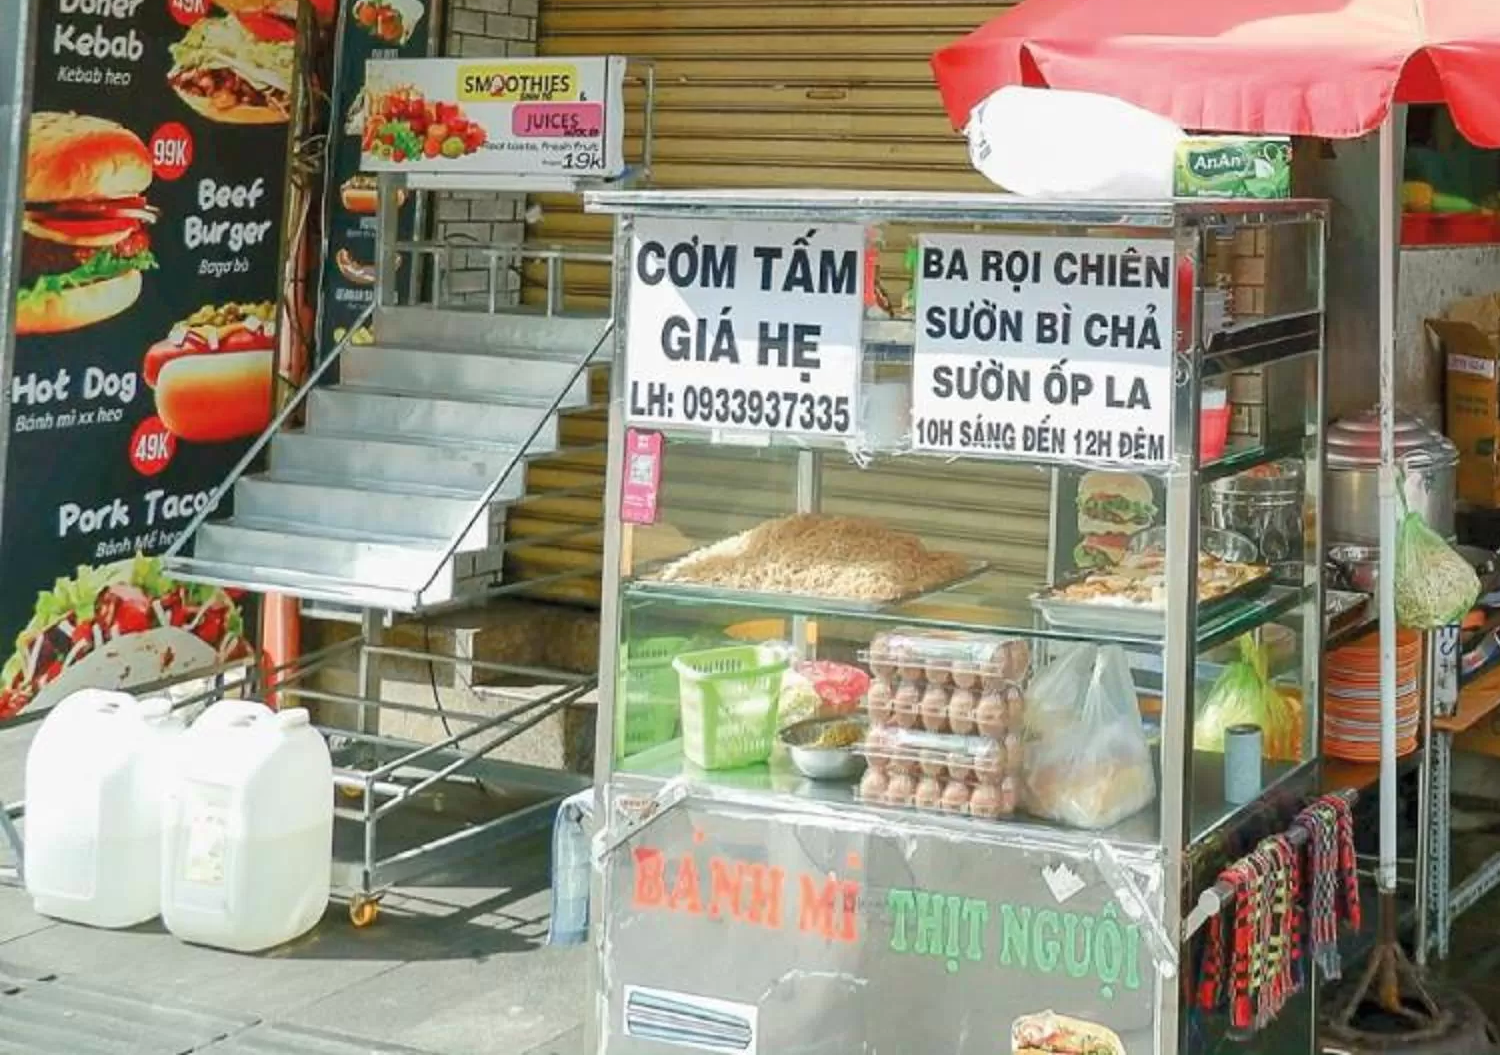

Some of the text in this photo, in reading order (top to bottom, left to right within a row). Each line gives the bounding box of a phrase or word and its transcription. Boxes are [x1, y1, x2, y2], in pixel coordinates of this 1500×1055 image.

[53, 24, 144, 61] Kebab
[57, 66, 131, 85] Kebab heo
[525, 113, 580, 132] JUICES
[153, 140, 187, 166] 99K
[1193, 153, 1241, 170] AnAn
[198, 177, 264, 211] Beef
[184, 215, 272, 252] Burger
[637, 229, 857, 295] CƠM TẤM
[923, 247, 1170, 292] BA RỌI CHIÊN
[926, 299, 1161, 349] SƯỜN BÌ CHẢ
[661, 306, 821, 383] GIÁ HẸ
[12, 366, 136, 404] Hot Dog
[933, 358, 1151, 409] SƯỜN ỐP LA
[97, 407, 123, 422] heo
[630, 381, 850, 432] LH: 0933937335
[134, 433, 169, 460] 49K
[916, 414, 1165, 461] 10H SÁNG ĐẾN 12H ĐÊM
[59, 498, 129, 537] Pork
[889, 888, 1142, 999] THỊT NGUỘI
